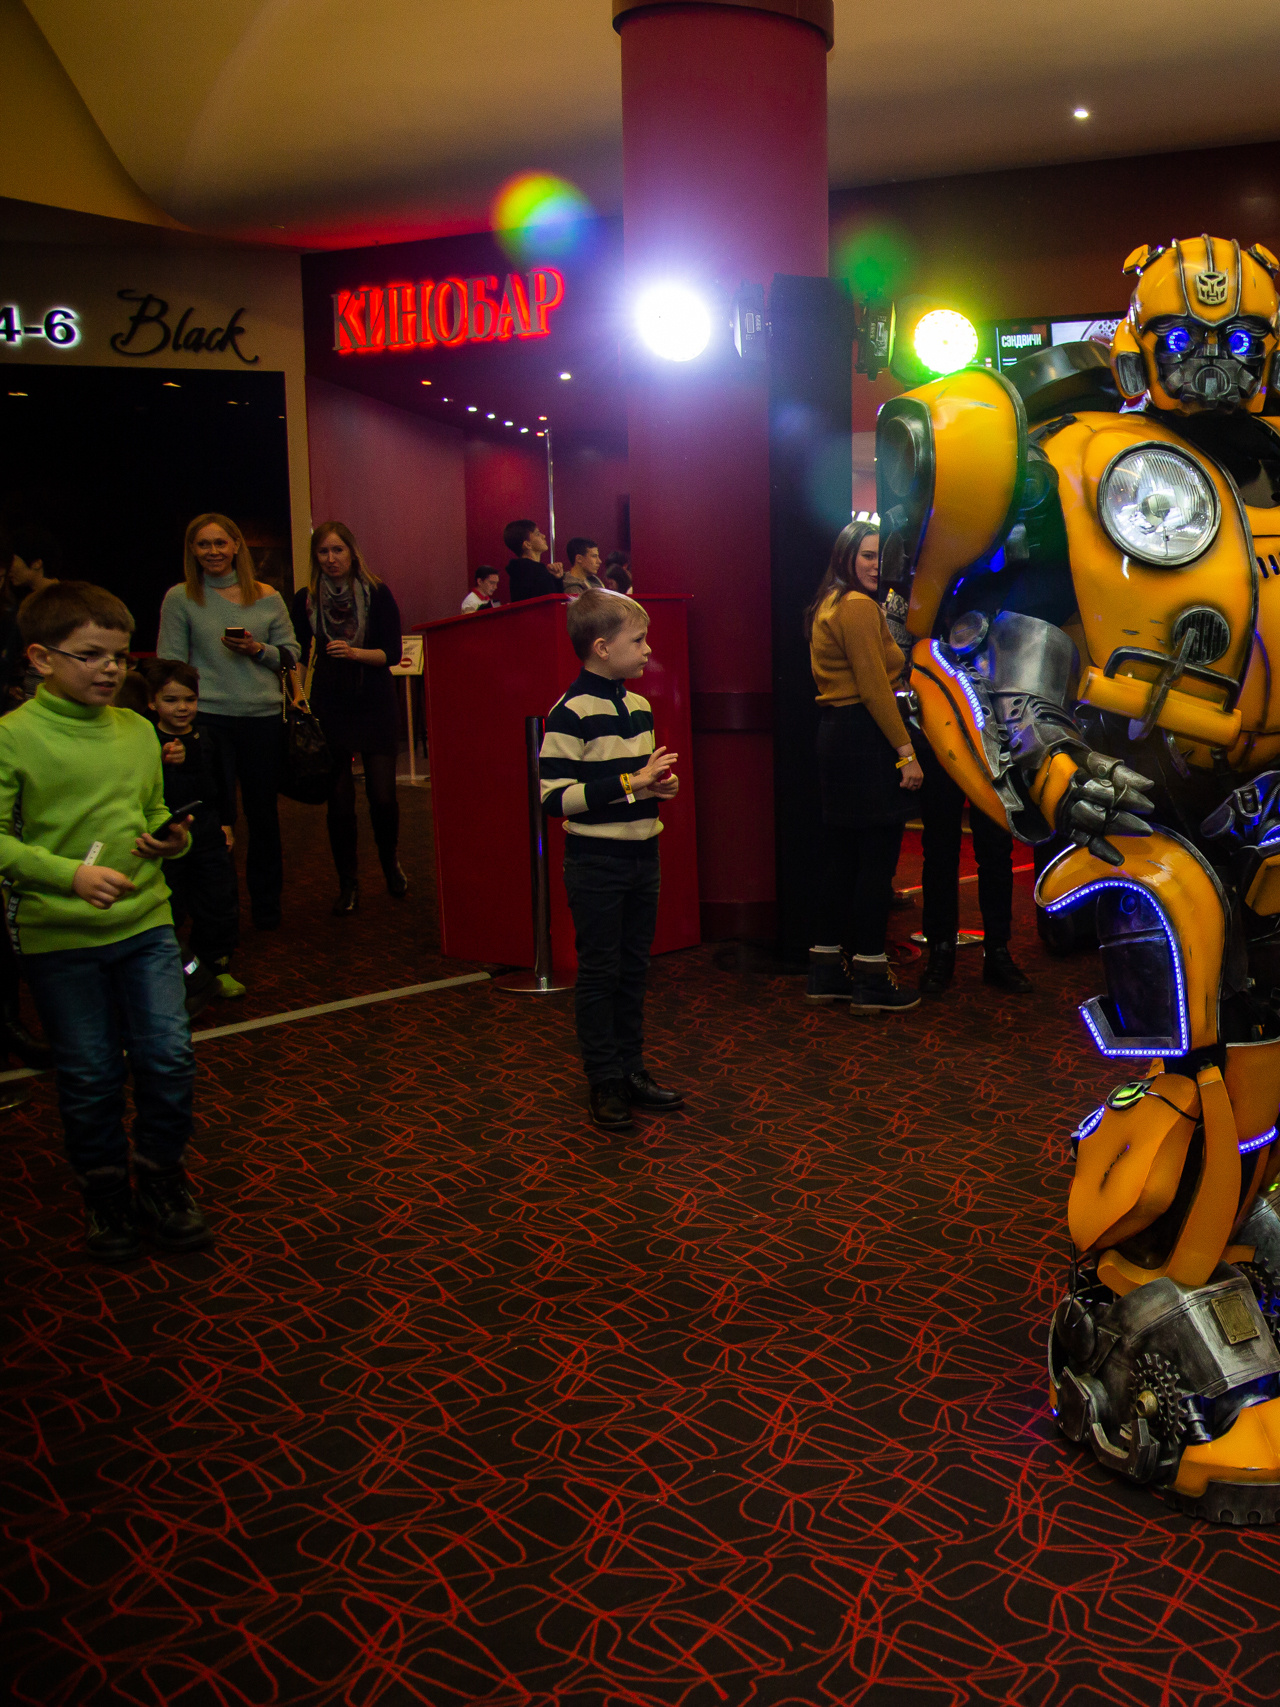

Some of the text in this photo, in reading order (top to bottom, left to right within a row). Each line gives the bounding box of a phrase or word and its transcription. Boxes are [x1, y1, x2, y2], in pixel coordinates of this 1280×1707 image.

[110, 288, 259, 364] Black
[331, 268, 565, 352] КИНОБАР
[1001, 334, 1042, 348] СЭНДВИЧИ
